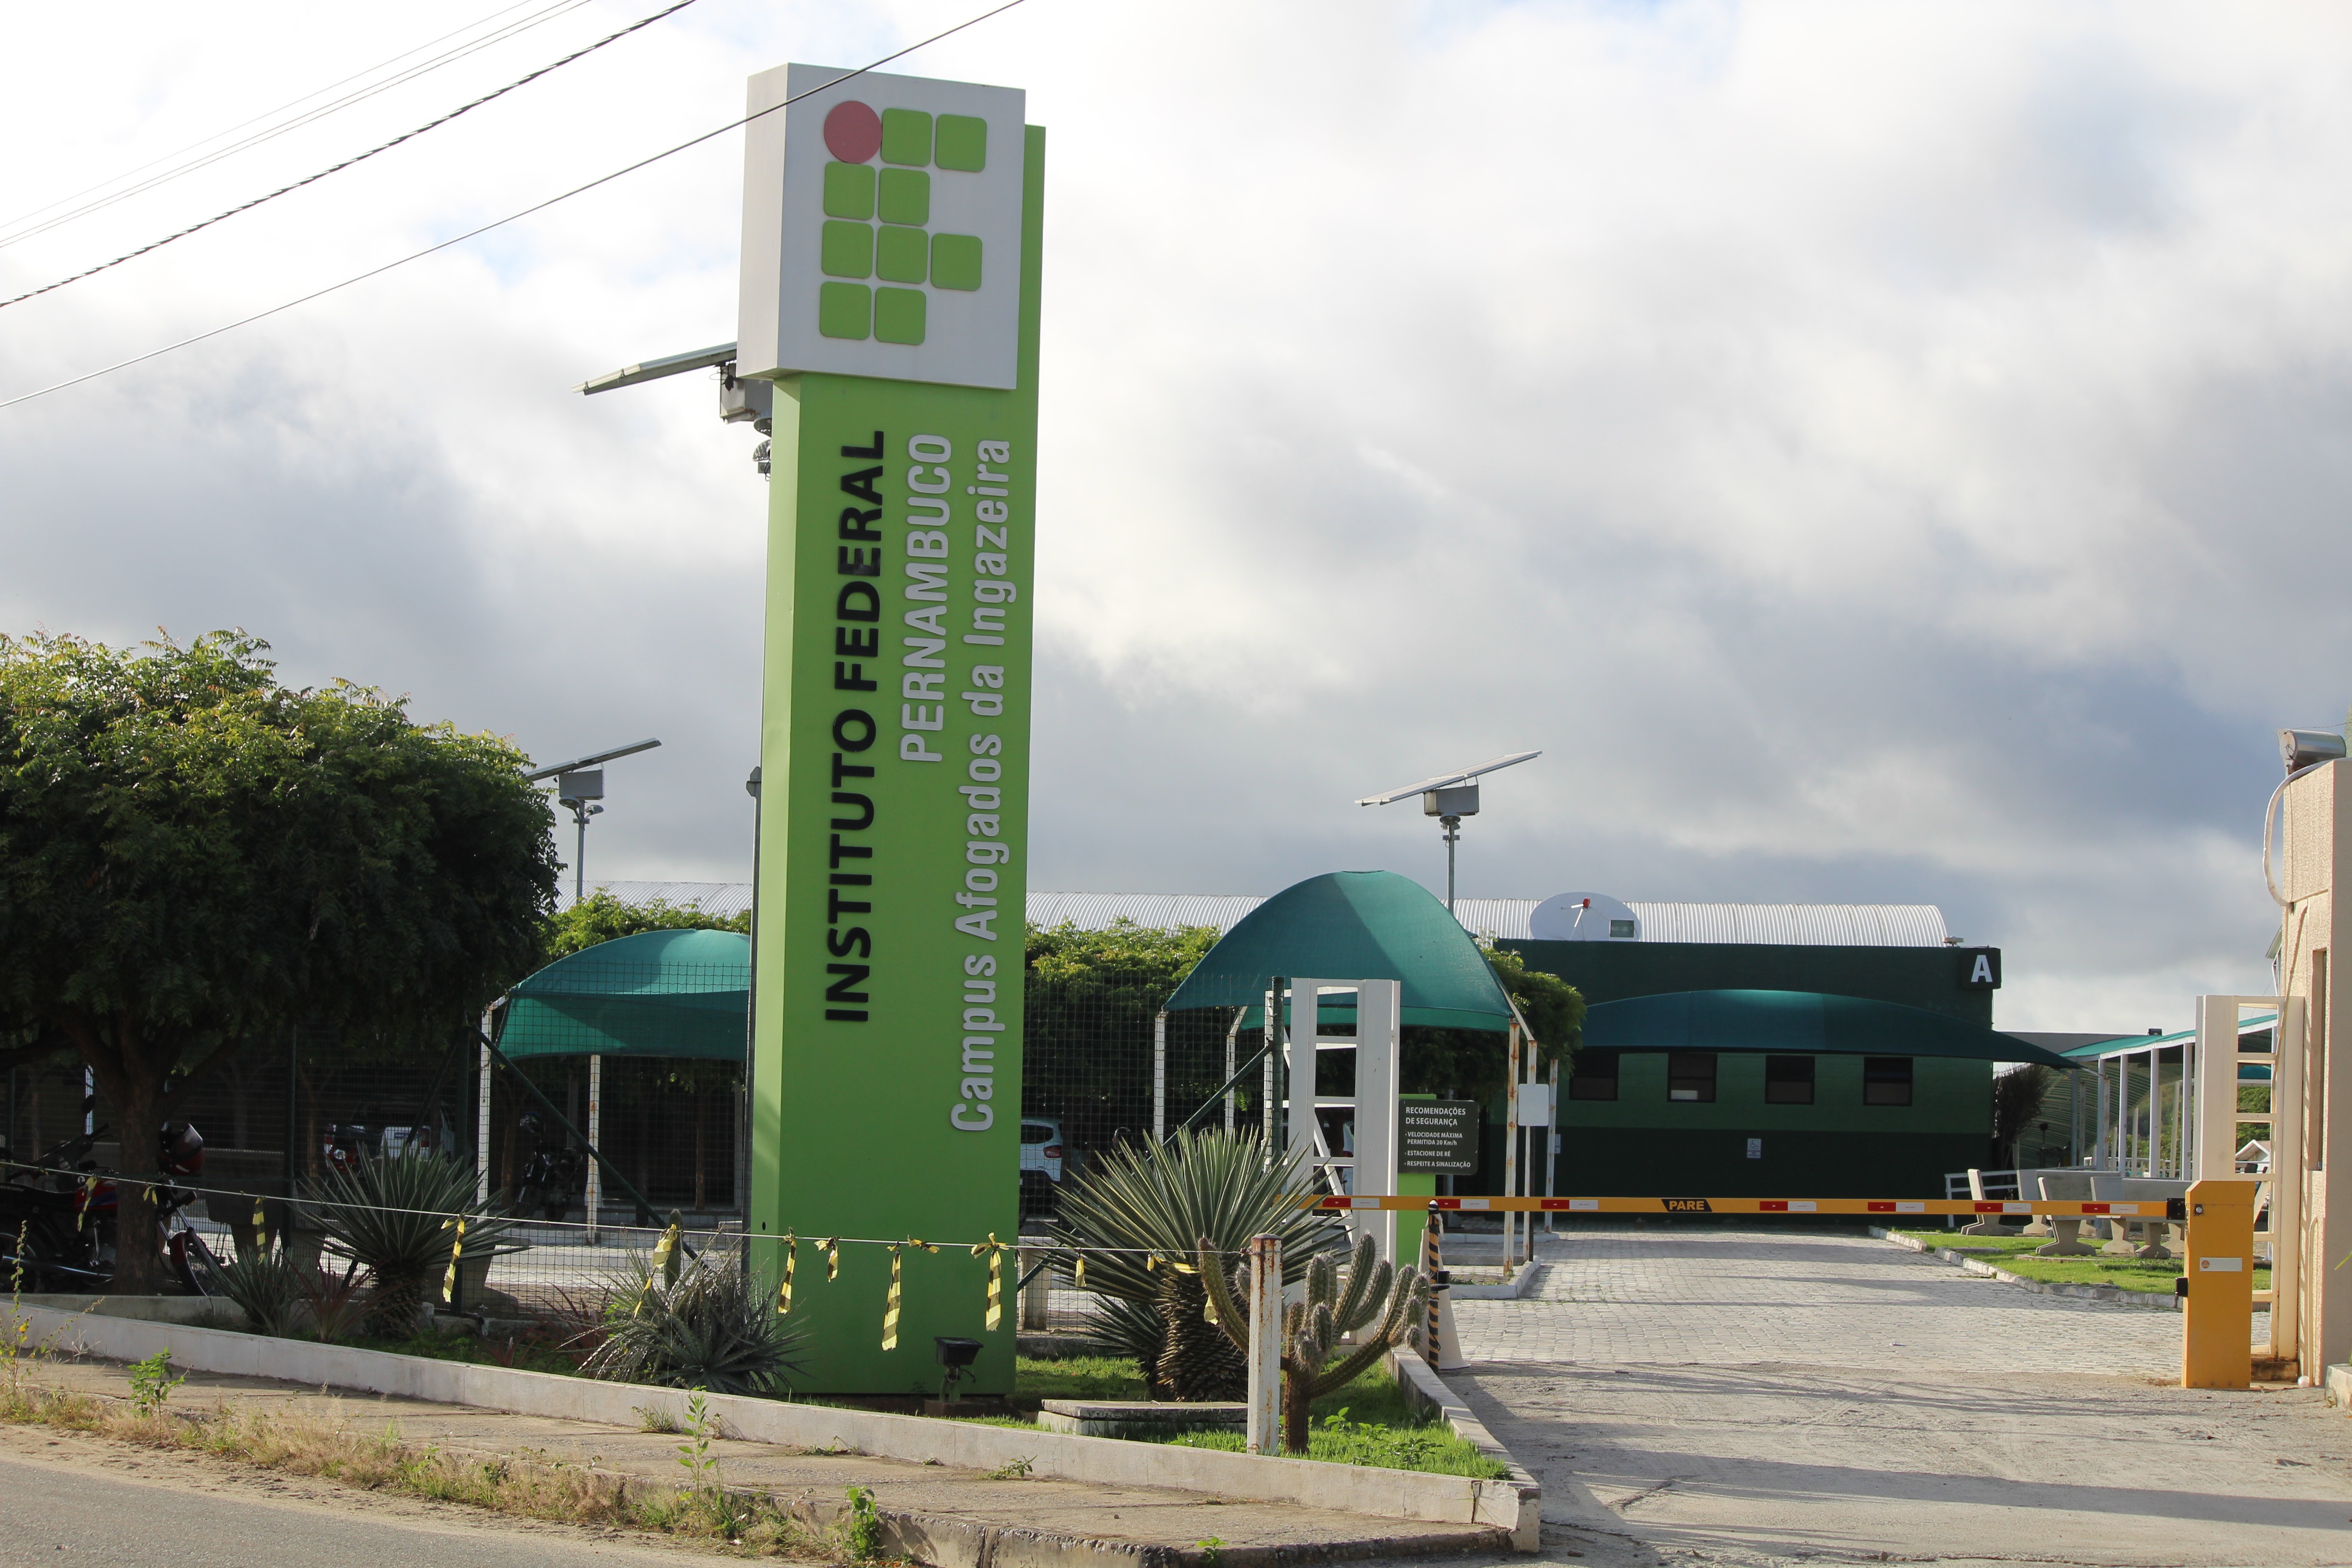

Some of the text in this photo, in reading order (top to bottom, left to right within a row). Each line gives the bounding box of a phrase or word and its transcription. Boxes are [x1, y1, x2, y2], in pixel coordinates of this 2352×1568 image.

[899, 433, 952, 763] PERNAMBUCO
[824, 430, 884, 1023] INSTITUTO FEDERAL
[950, 438, 1018, 1131] Campus Afogados da Ingazeira
[1971, 955, 1993, 982] A
[1406, 1107, 1466, 1117] RECOMENDAÇÕES
[1416, 1118, 1458, 1127] SEGURANÇA
[1669, 1200, 1705, 1210] PARE
